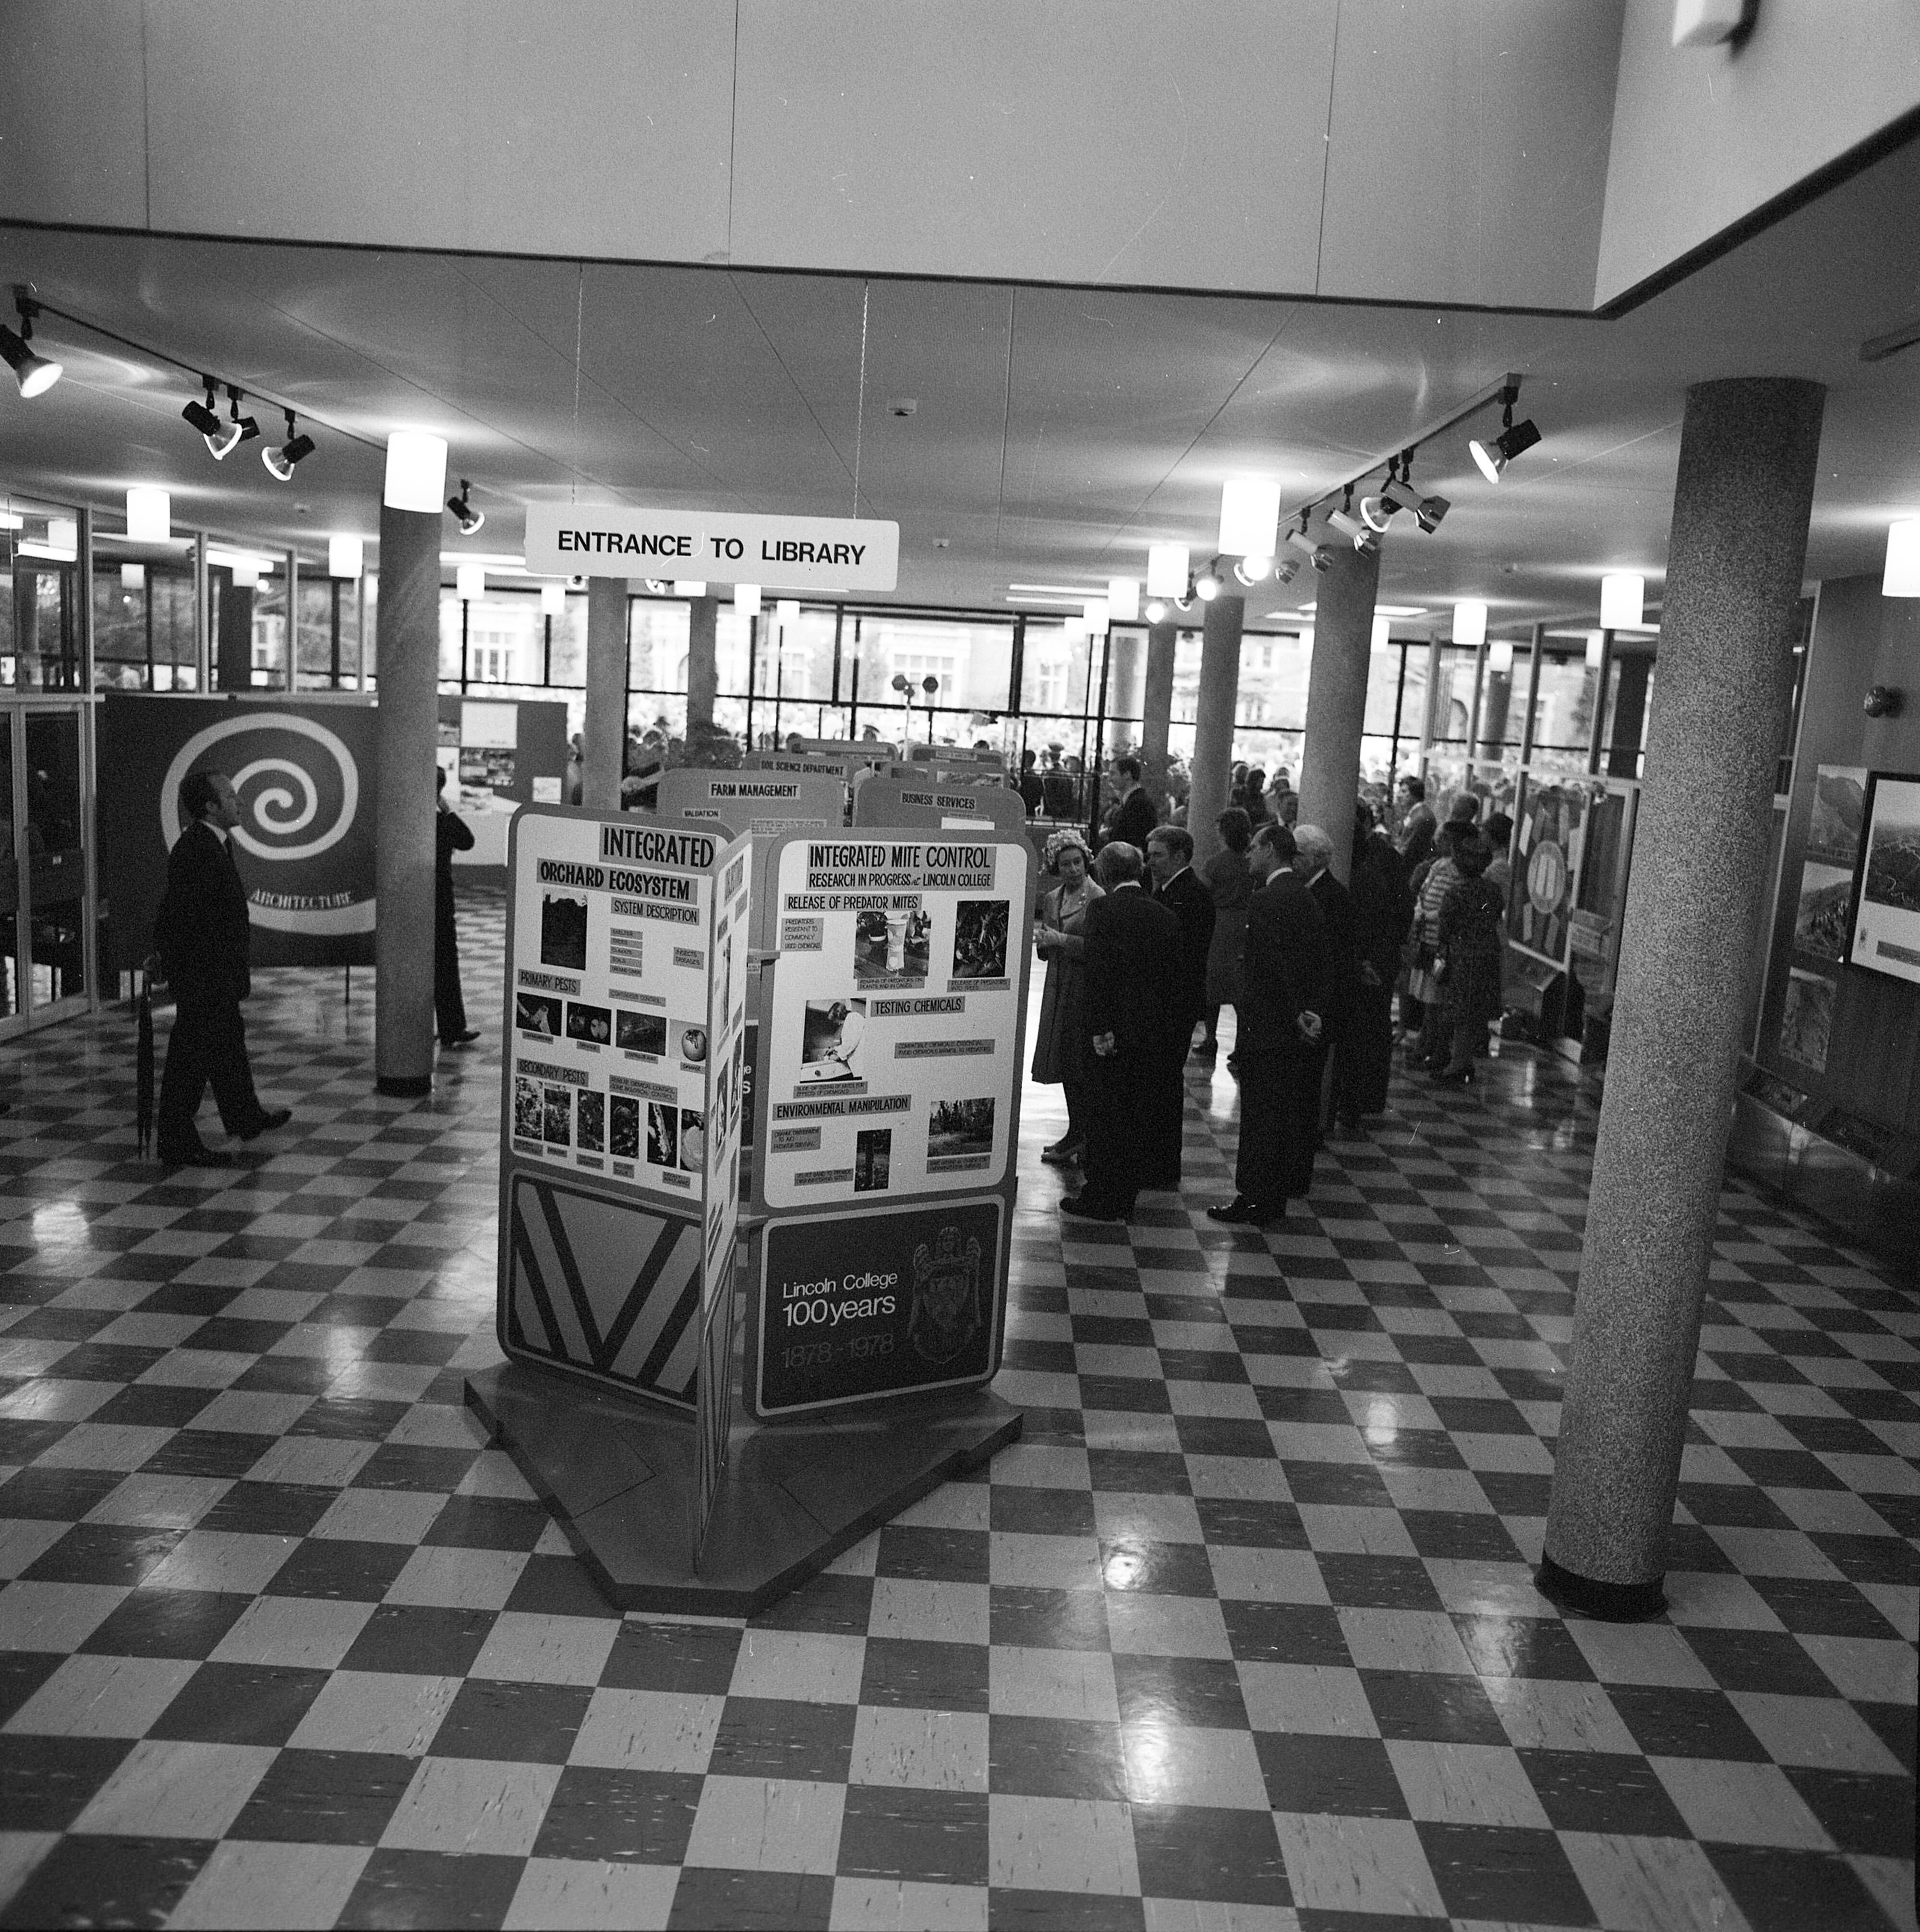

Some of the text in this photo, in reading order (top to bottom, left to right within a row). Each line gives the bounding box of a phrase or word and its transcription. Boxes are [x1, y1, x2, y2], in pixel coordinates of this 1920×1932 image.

[558, 530, 866, 565] ENTRANCE TO LIBRARY
[776, 761, 800, 772] SCIENCE
[803, 763, 844, 775] DEPARTMENT
[711, 784, 797, 797] FARM MANAGEMENT
[902, 793, 975, 809] BUSINESS SERVICES
[603, 827, 714, 868] INTEGRATED
[810, 845, 990, 868] INTEGRATED MITE CONTROL
[540, 861, 689, 900] ORCHARD ECOSYSTEM
[809, 873, 855, 887] RESEARCH
[858, 873, 867, 886] IN
[869, 873, 911, 886] PROGRESS
[923, 873, 955, 886] LINCOLN
[958, 873, 991, 887] COLLEGE
[250, 888, 351, 910] ARCHITECTURE
[788, 895, 918, 909] RELEASE OF PREDATOR MITES
[614, 901, 697, 923] SYSTEM DESCRIPTION
[521, 971, 576, 992] PRIMARY PESTS
[875, 998, 962, 1015] TESTING CHEMICALS
[519, 1063, 586, 1085] SECONDARY PESTS
[777, 1097, 908, 1118] ENVIRONMENTAL MANIPULATION
[783, 1272, 898, 1298] Lincoln College
